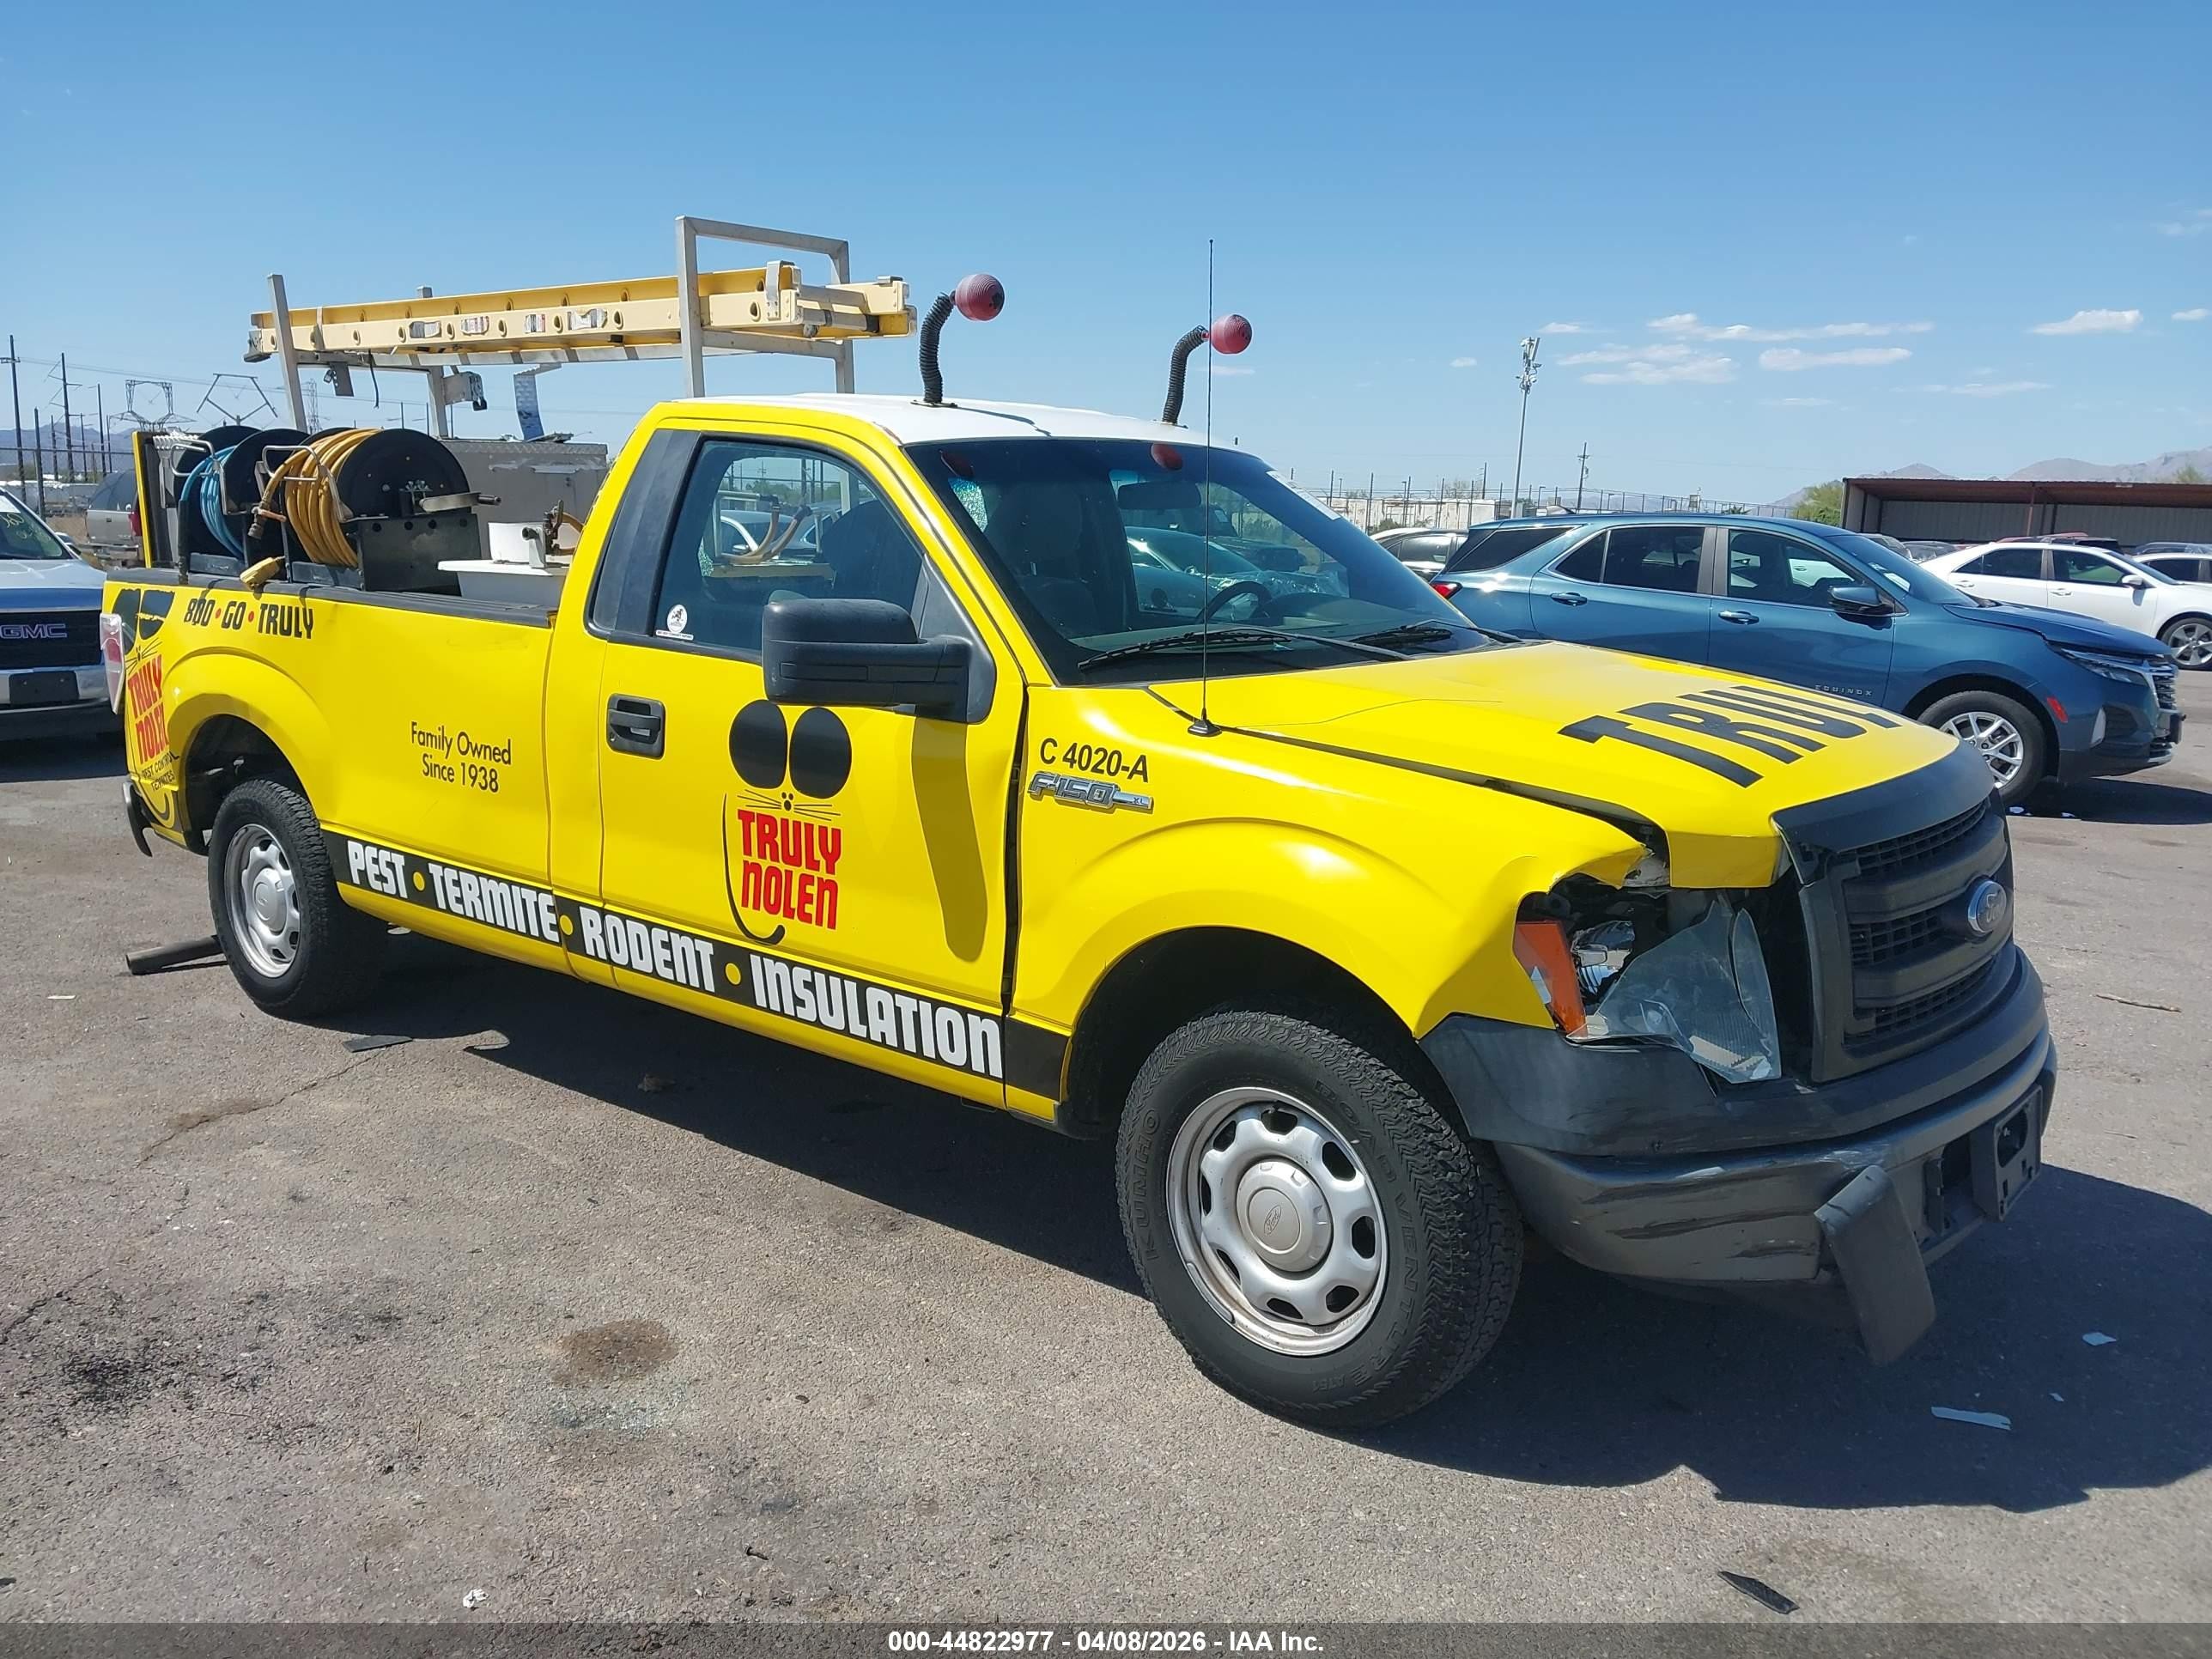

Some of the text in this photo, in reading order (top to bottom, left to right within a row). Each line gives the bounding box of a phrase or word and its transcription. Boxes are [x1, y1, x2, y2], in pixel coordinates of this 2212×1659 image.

[0, 623, 68, 639] GMC
[184, 598, 313, 639] 800 GO TRULY
[127, 654, 163, 719] TRULY
[1814, 684, 1872, 696] EQUINOX
[135, 702, 170, 764] NOLEN
[411, 721, 511, 765] Family Owned
[422, 752, 499, 793] Since 1938
[1040, 738, 1149, 783] C 4020-A
[738, 809, 842, 875] TRULY
[741, 860, 838, 930] NOLEN
[347, 841, 1003, 1079] PEST TERMITE RODENT INSULATION
